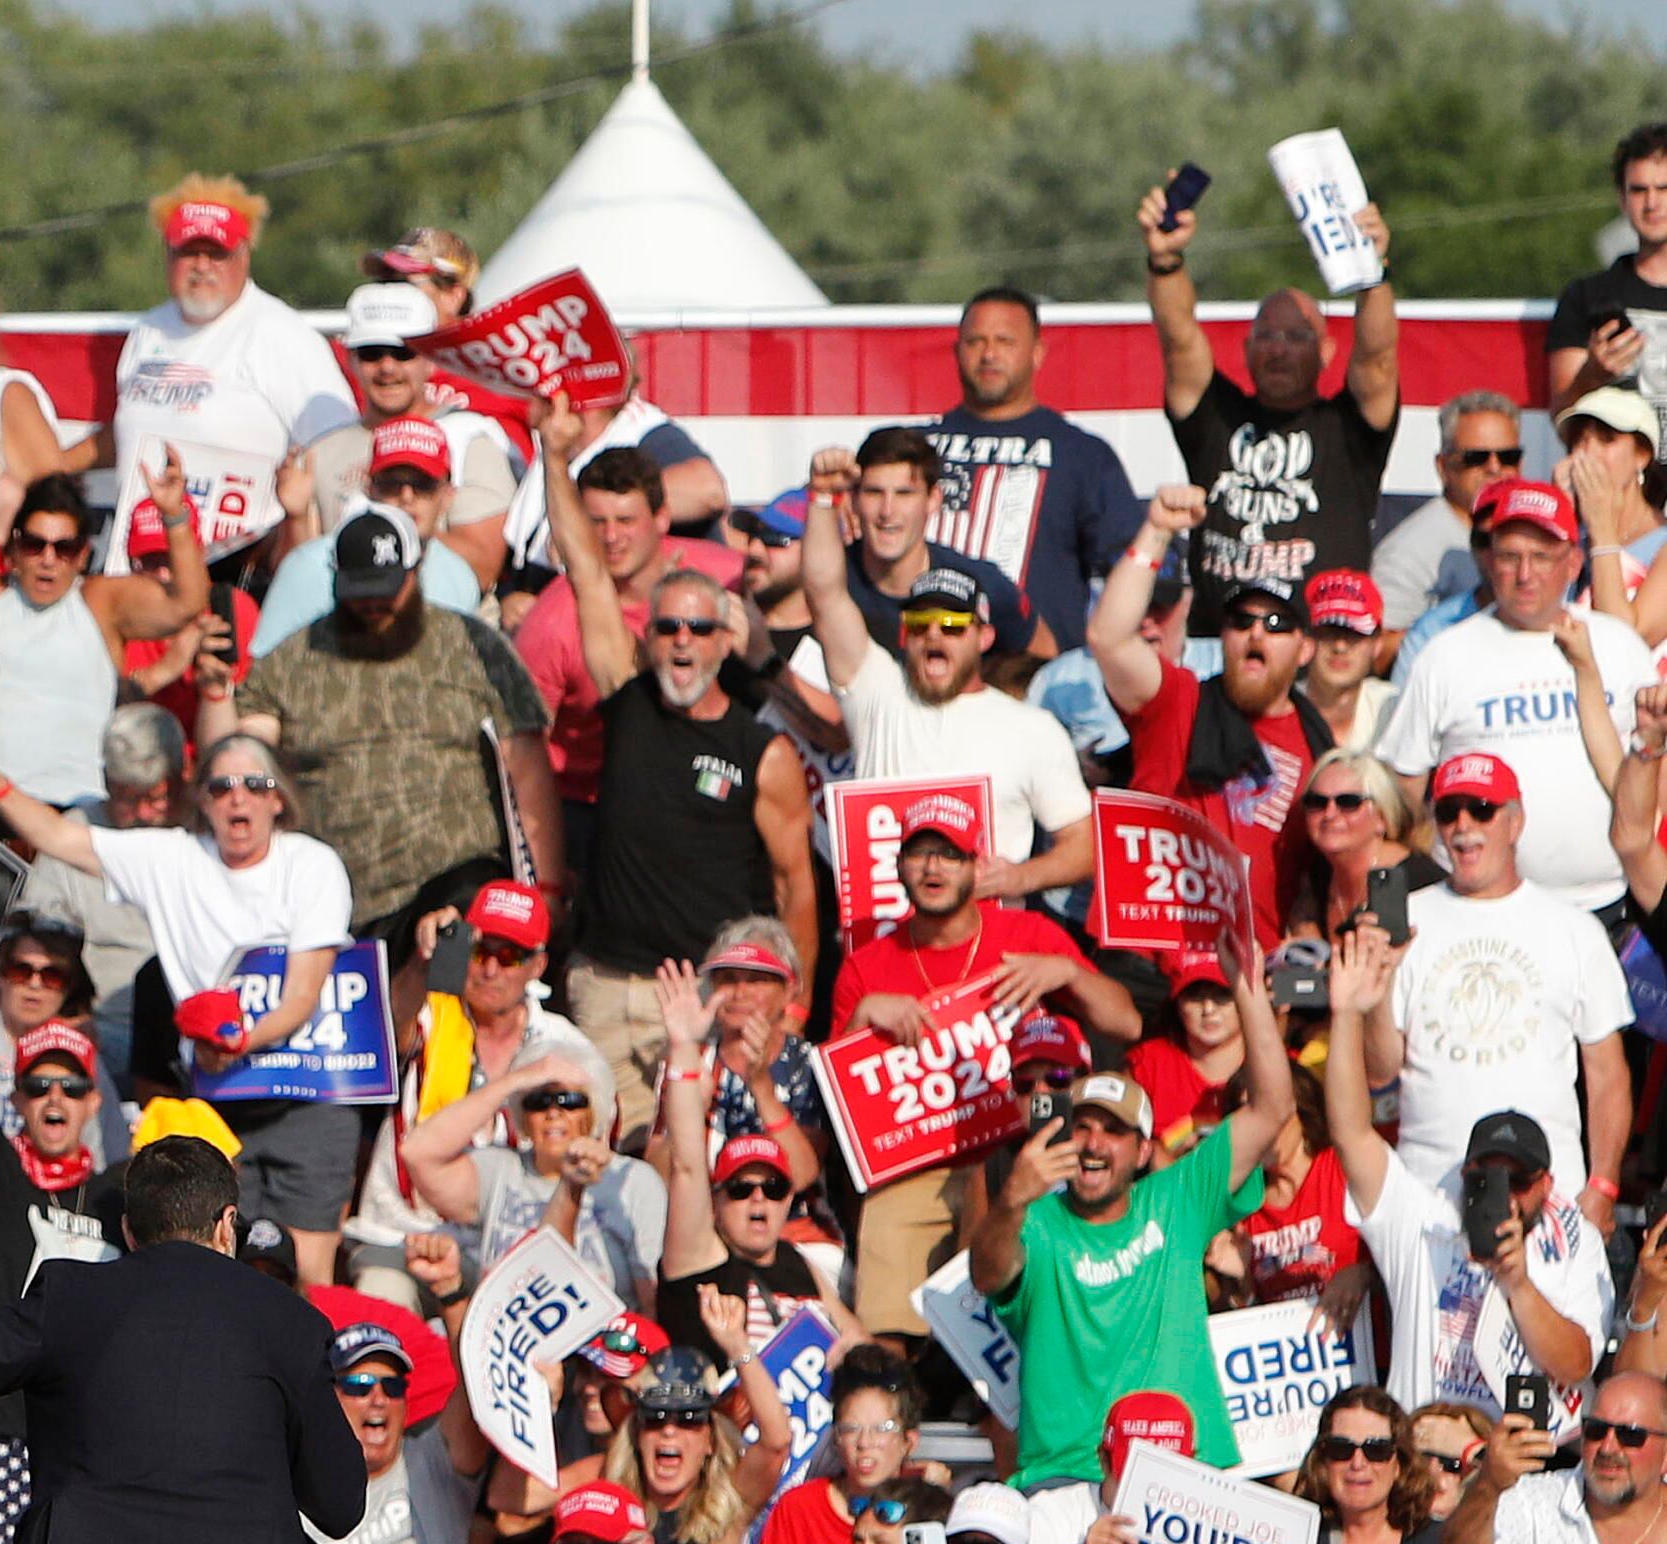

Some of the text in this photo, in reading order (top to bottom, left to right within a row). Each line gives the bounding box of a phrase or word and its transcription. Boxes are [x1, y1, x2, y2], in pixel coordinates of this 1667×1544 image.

[460, 295, 588, 366] RUMP
[1201, 528, 1316, 580] TRUMP
[1119, 905, 1220, 925] TEXT TRUMP
[848, 1006, 1023, 1096] TRUMP
[888, 1043, 1013, 1125] 2024
[872, 1125, 916, 1153] TEXT
[918, 1103, 978, 1136] TRUMP
[1250, 1215, 1322, 1257] TRUMP
[492, 1274, 554, 1416] YOU'RE
[510, 1285, 594, 1452] FIRED!
[1145, 1481, 1240, 1530] CROOKED
